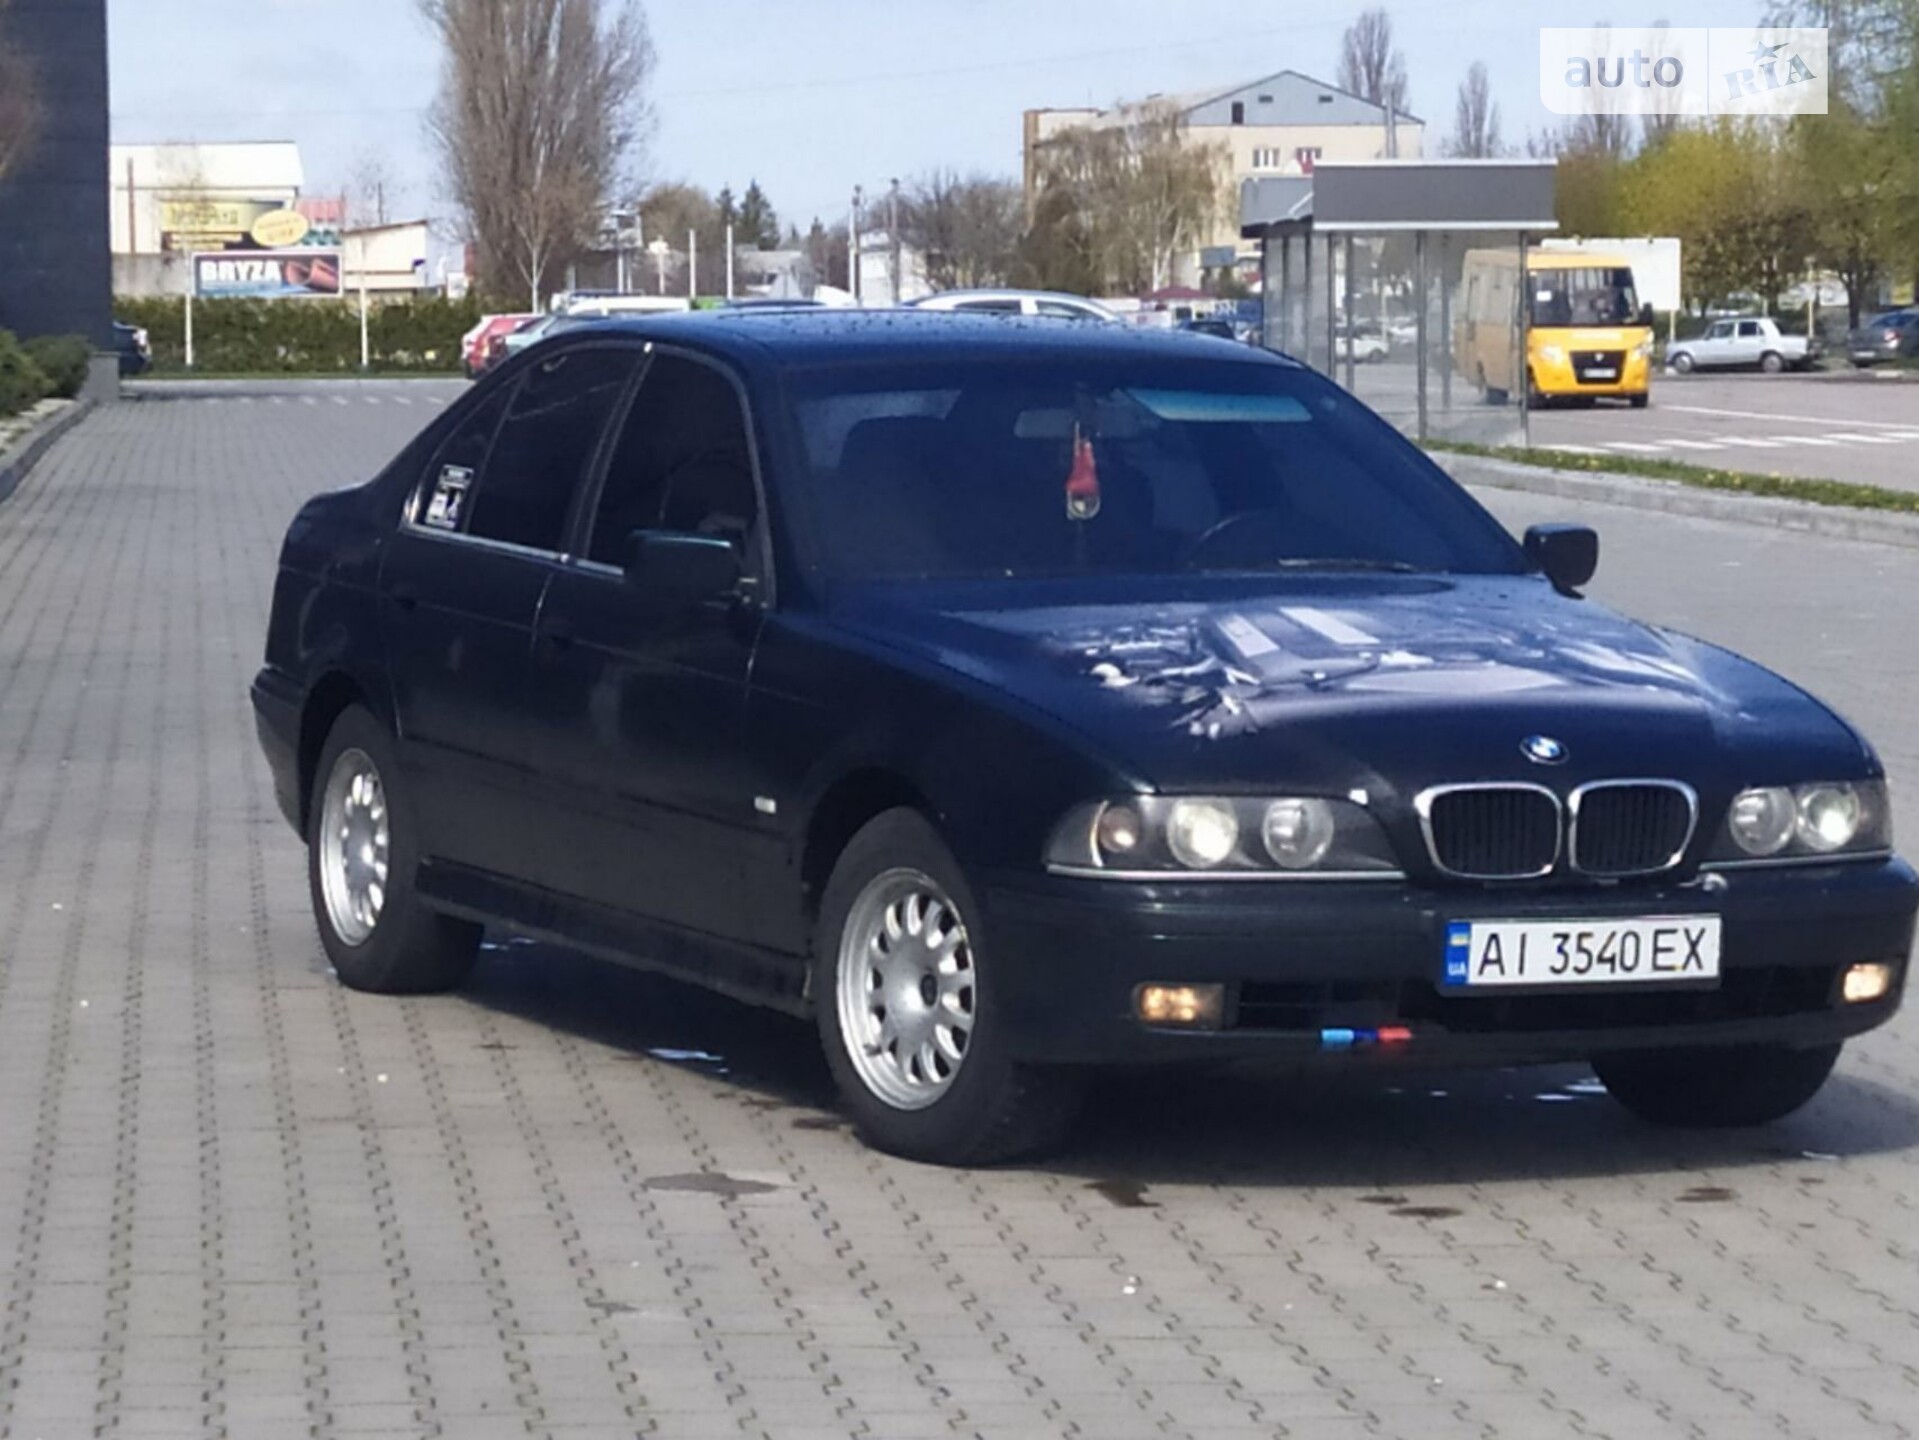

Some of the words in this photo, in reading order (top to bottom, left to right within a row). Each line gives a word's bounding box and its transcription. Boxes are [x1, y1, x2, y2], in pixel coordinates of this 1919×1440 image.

[201, 260, 281, 281] BRYZA
[1478, 932, 1527, 976] AI
[1550, 930, 1640, 975] 3540
[1651, 927, 1706, 972] EX
